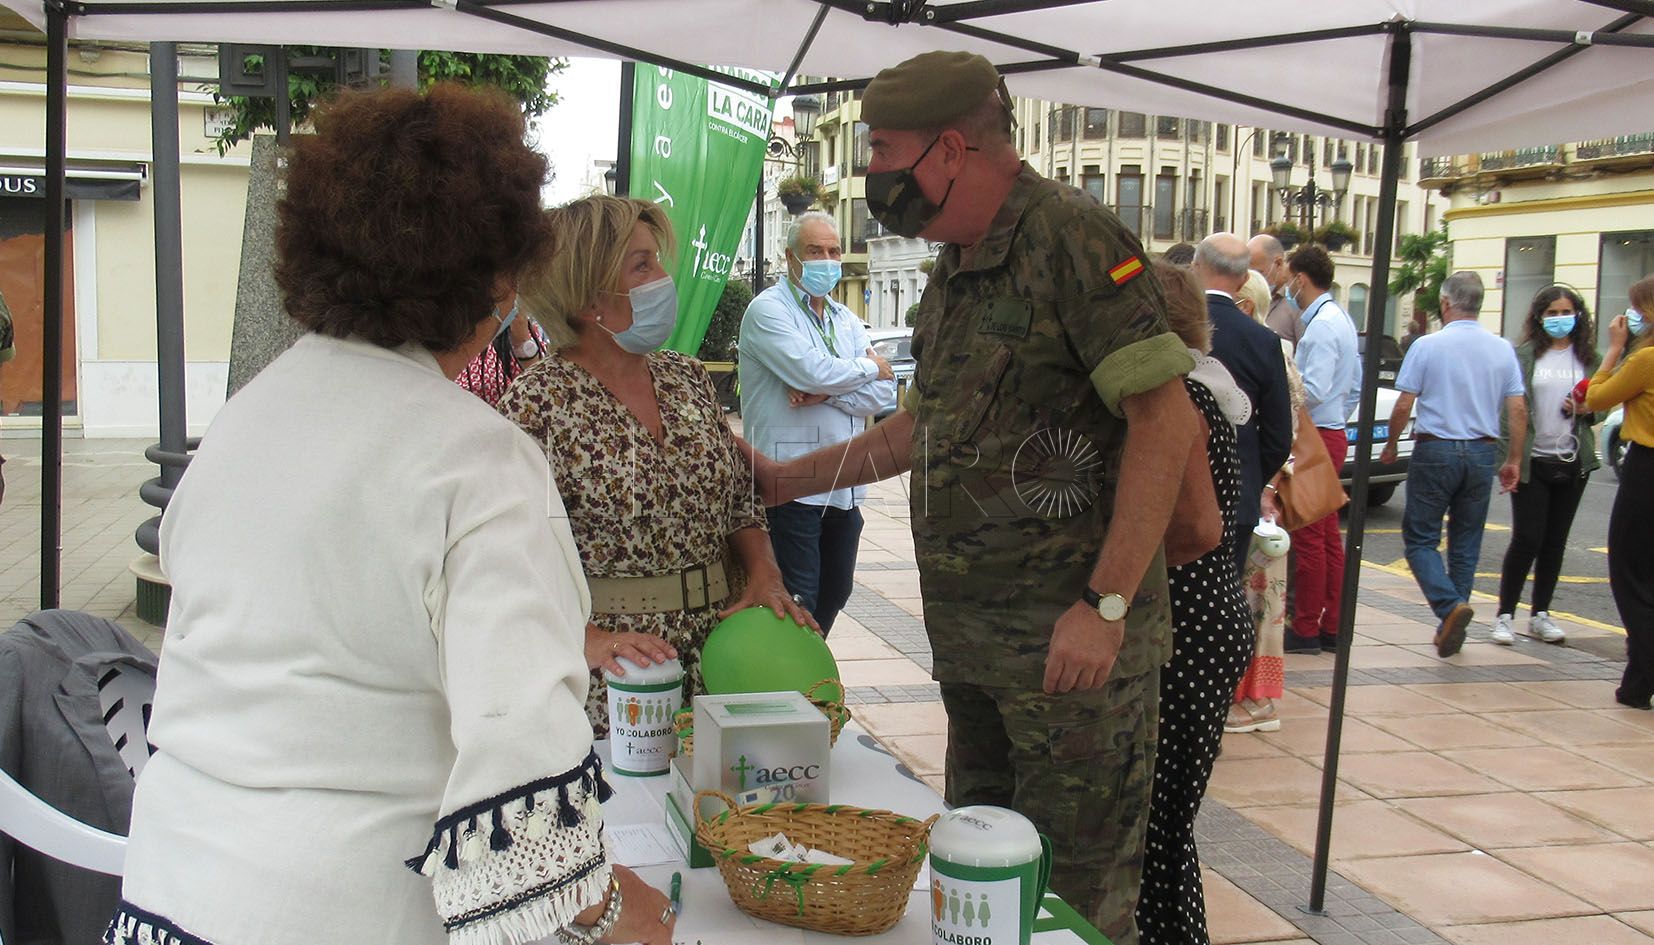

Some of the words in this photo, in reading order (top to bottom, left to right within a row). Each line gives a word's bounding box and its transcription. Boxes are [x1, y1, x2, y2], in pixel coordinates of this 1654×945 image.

[712, 91, 733, 118] LA
[736, 101, 768, 135] CARA
[708, 121, 729, 136] CONTRA
[0, 177, 37, 193] US
[616, 727, 625, 736] YO
[626, 727, 672, 739] COLABORO
[756, 765, 820, 784] aecc
[959, 815, 993, 832] aecc
